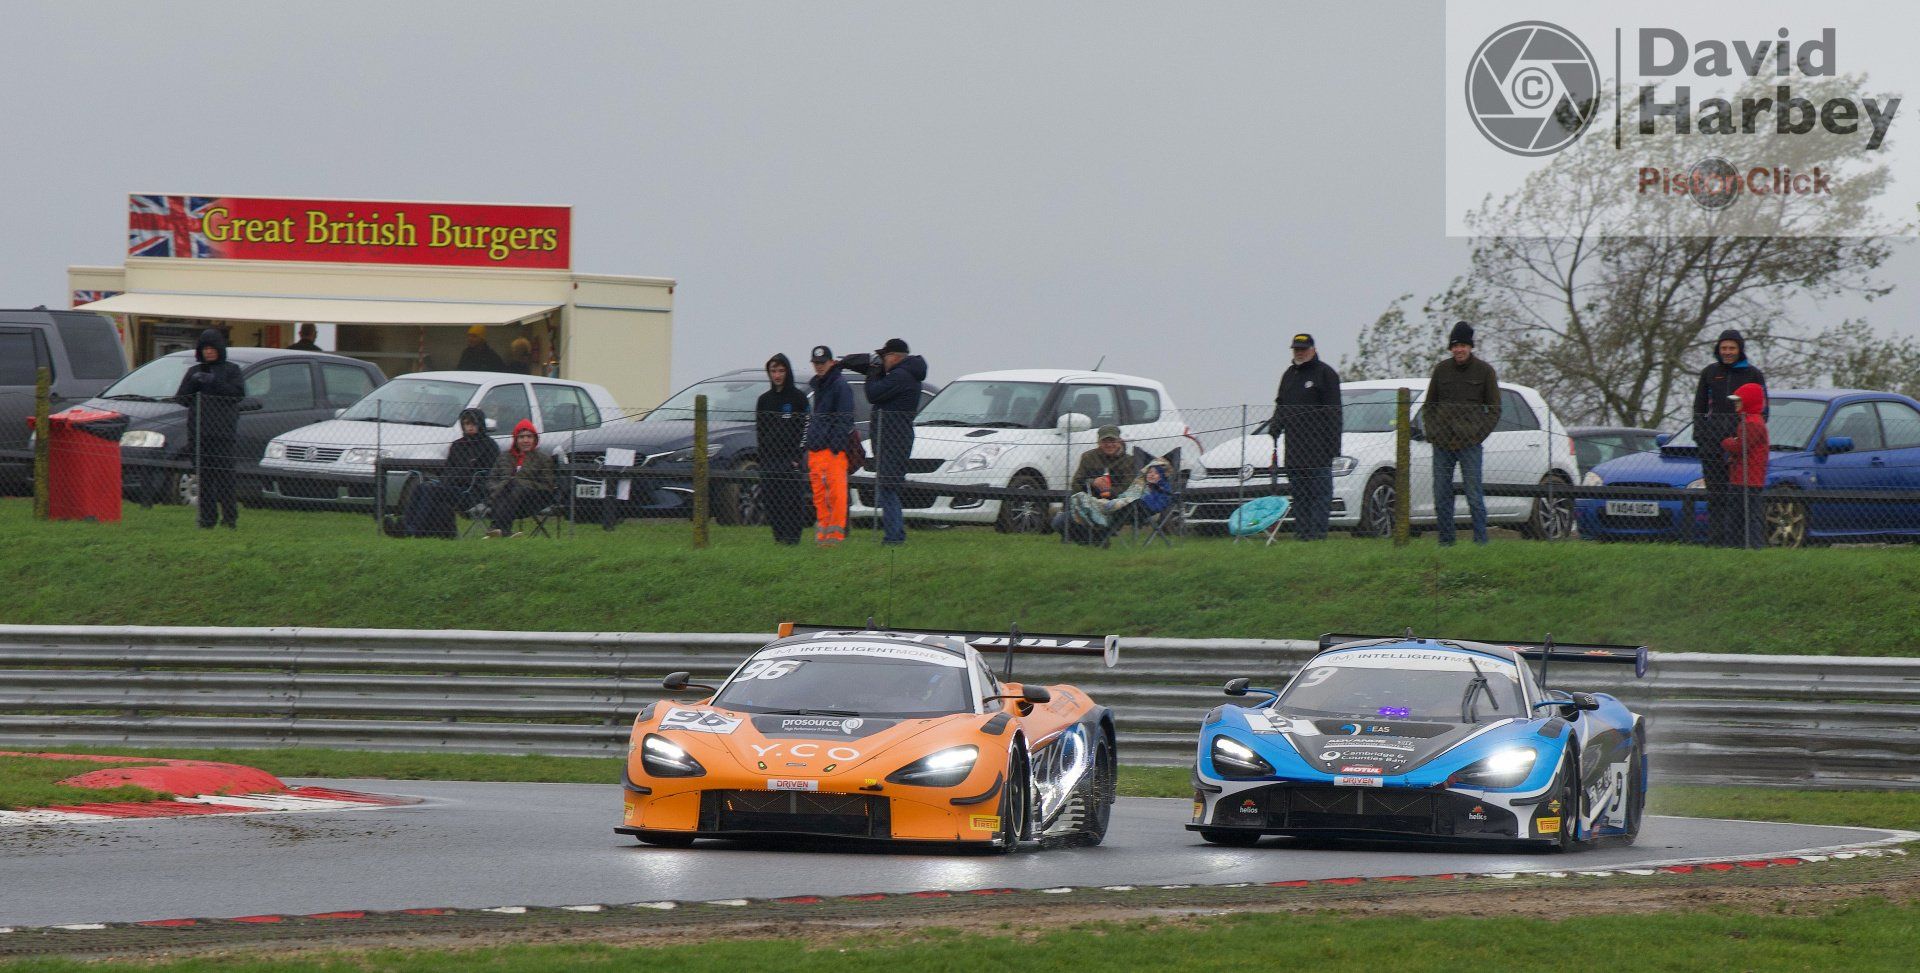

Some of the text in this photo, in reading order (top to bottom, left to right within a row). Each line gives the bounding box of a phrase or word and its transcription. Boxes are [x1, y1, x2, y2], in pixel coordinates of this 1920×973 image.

[202, 207, 558, 260] Great British Burgers
[732, 660, 800, 682] 96
[1298, 666, 1338, 688] 9
[667, 711, 736, 727] 96
[1343, 750, 1394, 758] Cambridge
[776, 780, 809, 789] DRIVEN
[1342, 777, 1374, 785] DRIVEN
